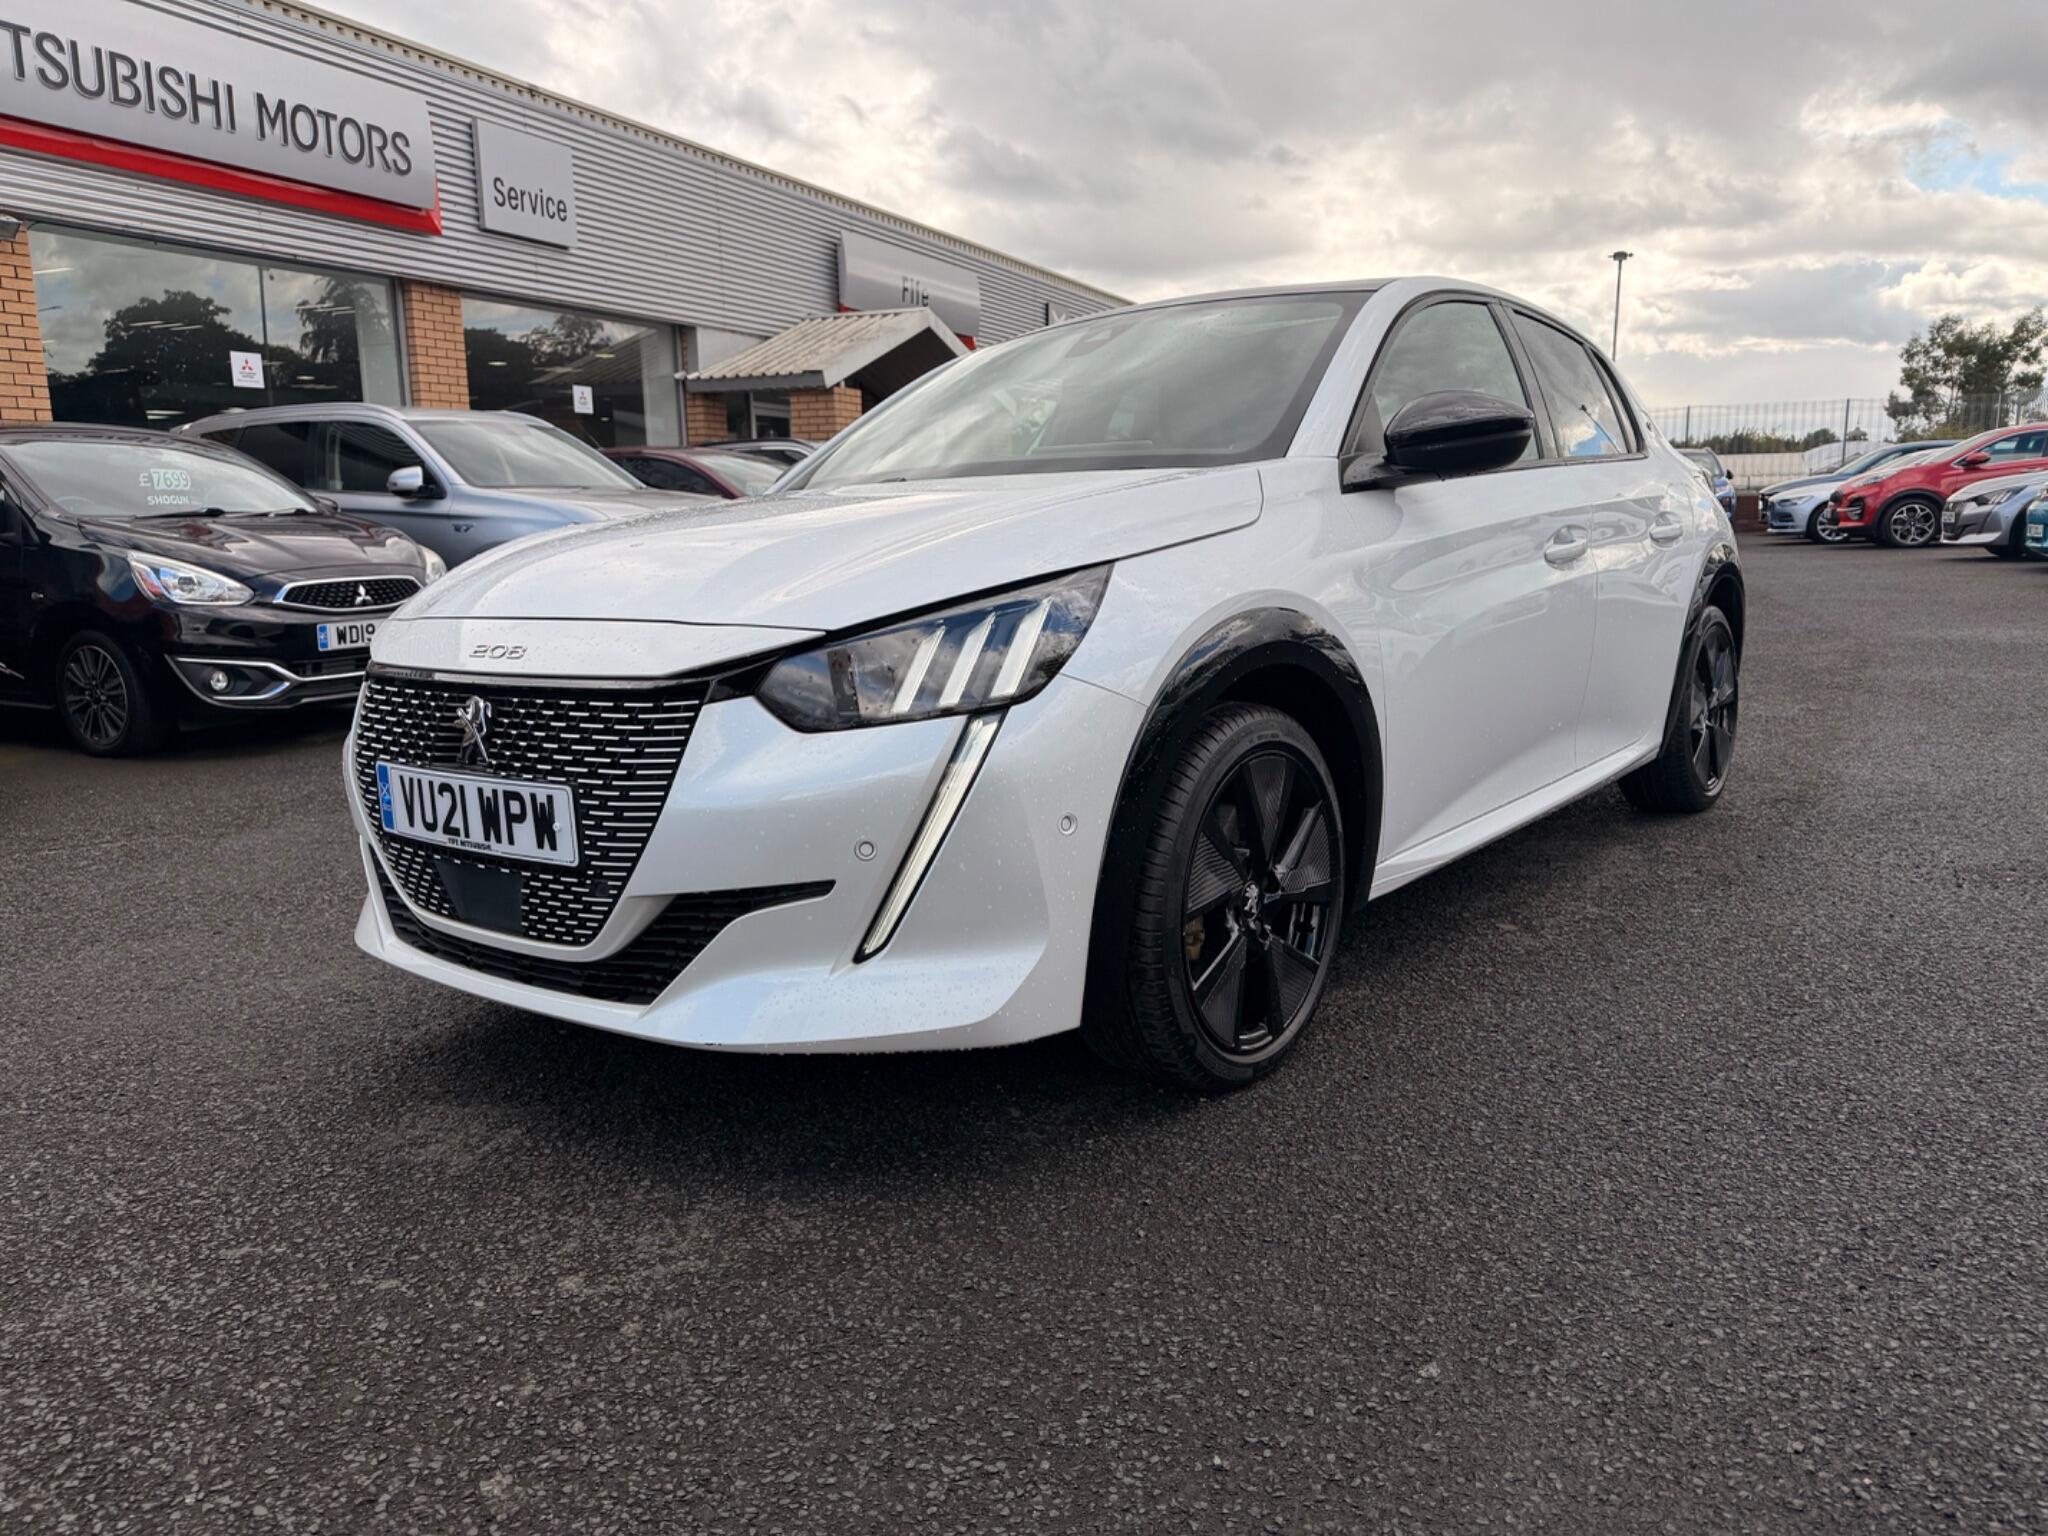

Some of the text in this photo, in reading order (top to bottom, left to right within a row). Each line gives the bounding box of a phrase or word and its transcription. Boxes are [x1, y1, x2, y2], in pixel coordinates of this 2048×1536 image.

[0, 19, 412, 176] TSUBISHI MOTORS
[493, 176, 567, 222] Service
[336, 623, 375, 645] WD19
[469, 644, 527, 660] 208
[399, 774, 558, 851] VU21 WPW
